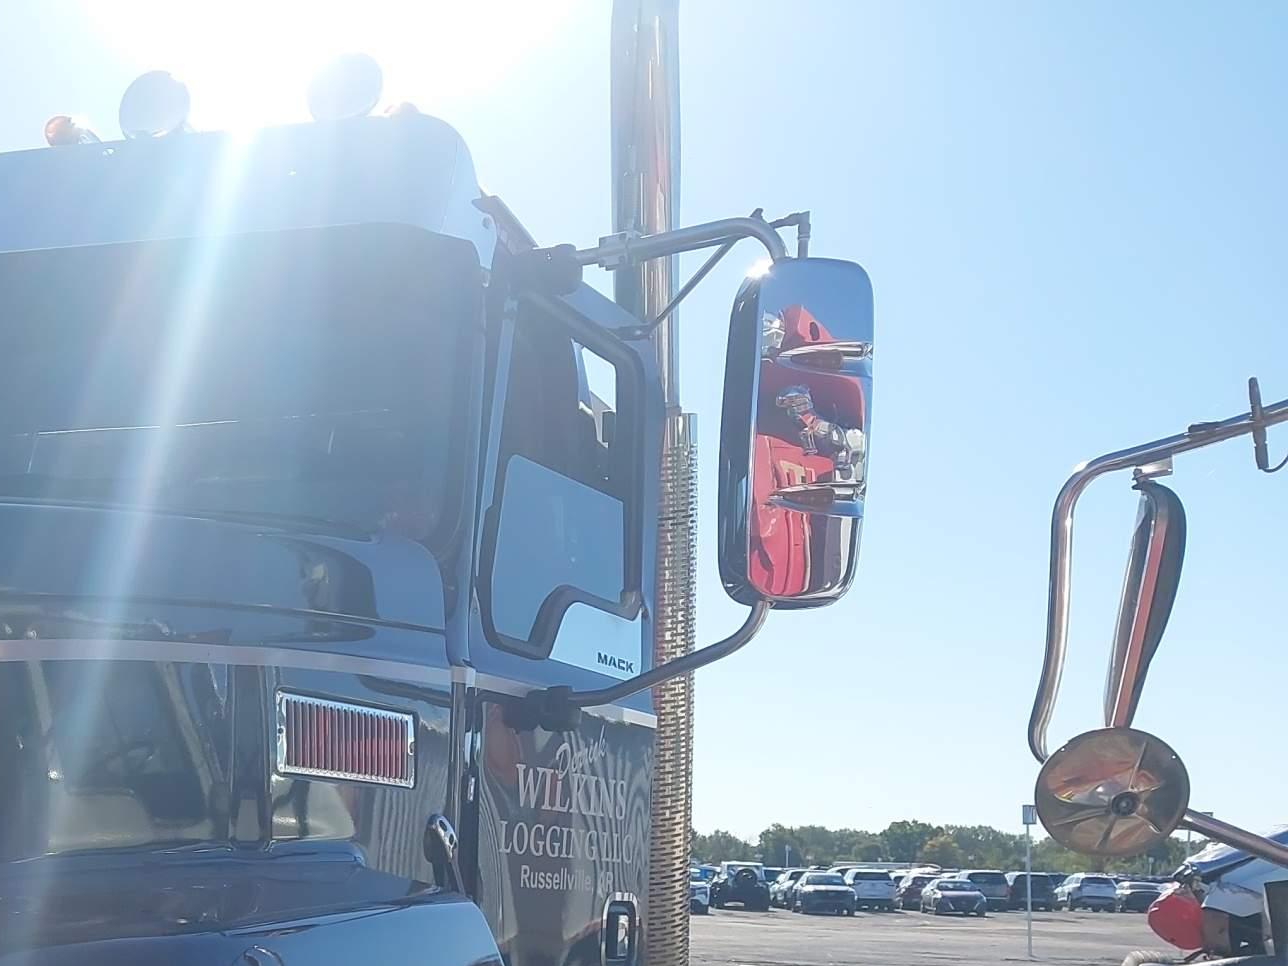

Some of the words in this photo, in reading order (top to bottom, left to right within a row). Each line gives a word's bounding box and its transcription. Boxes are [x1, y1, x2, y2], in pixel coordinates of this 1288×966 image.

[597, 651, 634, 674] MACK
[515, 763, 627, 821] WILKINS
[498, 820, 598, 862] LOGGING
[601, 831, 634, 864] LLC
